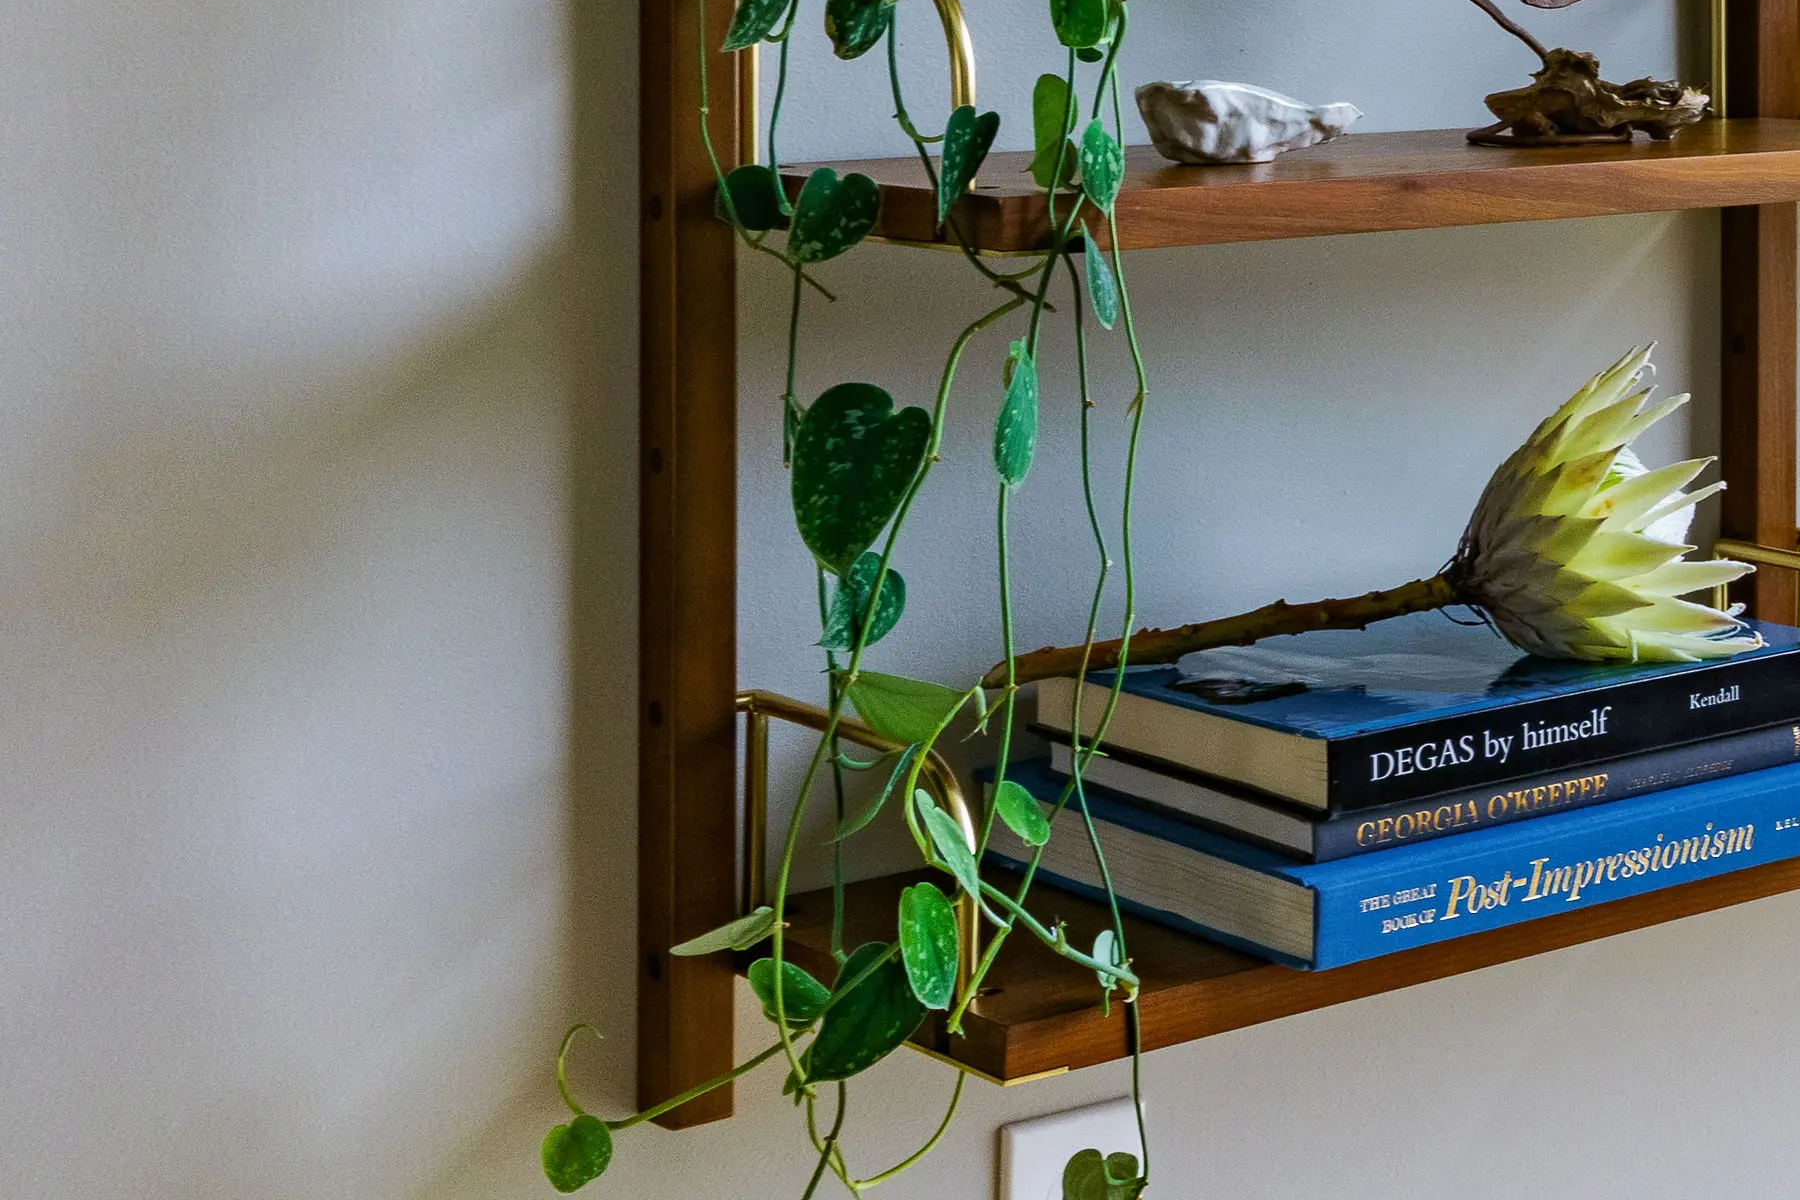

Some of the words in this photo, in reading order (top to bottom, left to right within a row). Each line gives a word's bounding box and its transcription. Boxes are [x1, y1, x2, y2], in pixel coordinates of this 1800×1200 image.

[1689, 685, 1740, 710] Kendall
[1370, 735, 1475, 782] DEGAS
[1482, 730, 1514, 764] by
[1522, 706, 1612, 750] himself
[1356, 799, 1480, 847] GEORGIA
[1487, 773, 1609, 820] O'KEEFFE
[1440, 822, 1756, 921] Post-Impressionism
[1359, 895, 1390, 913] THE
[1392, 883, 1437, 905] GREAT
[1381, 912, 1419, 933] BOOK
[1418, 908, 1437, 924] OF
